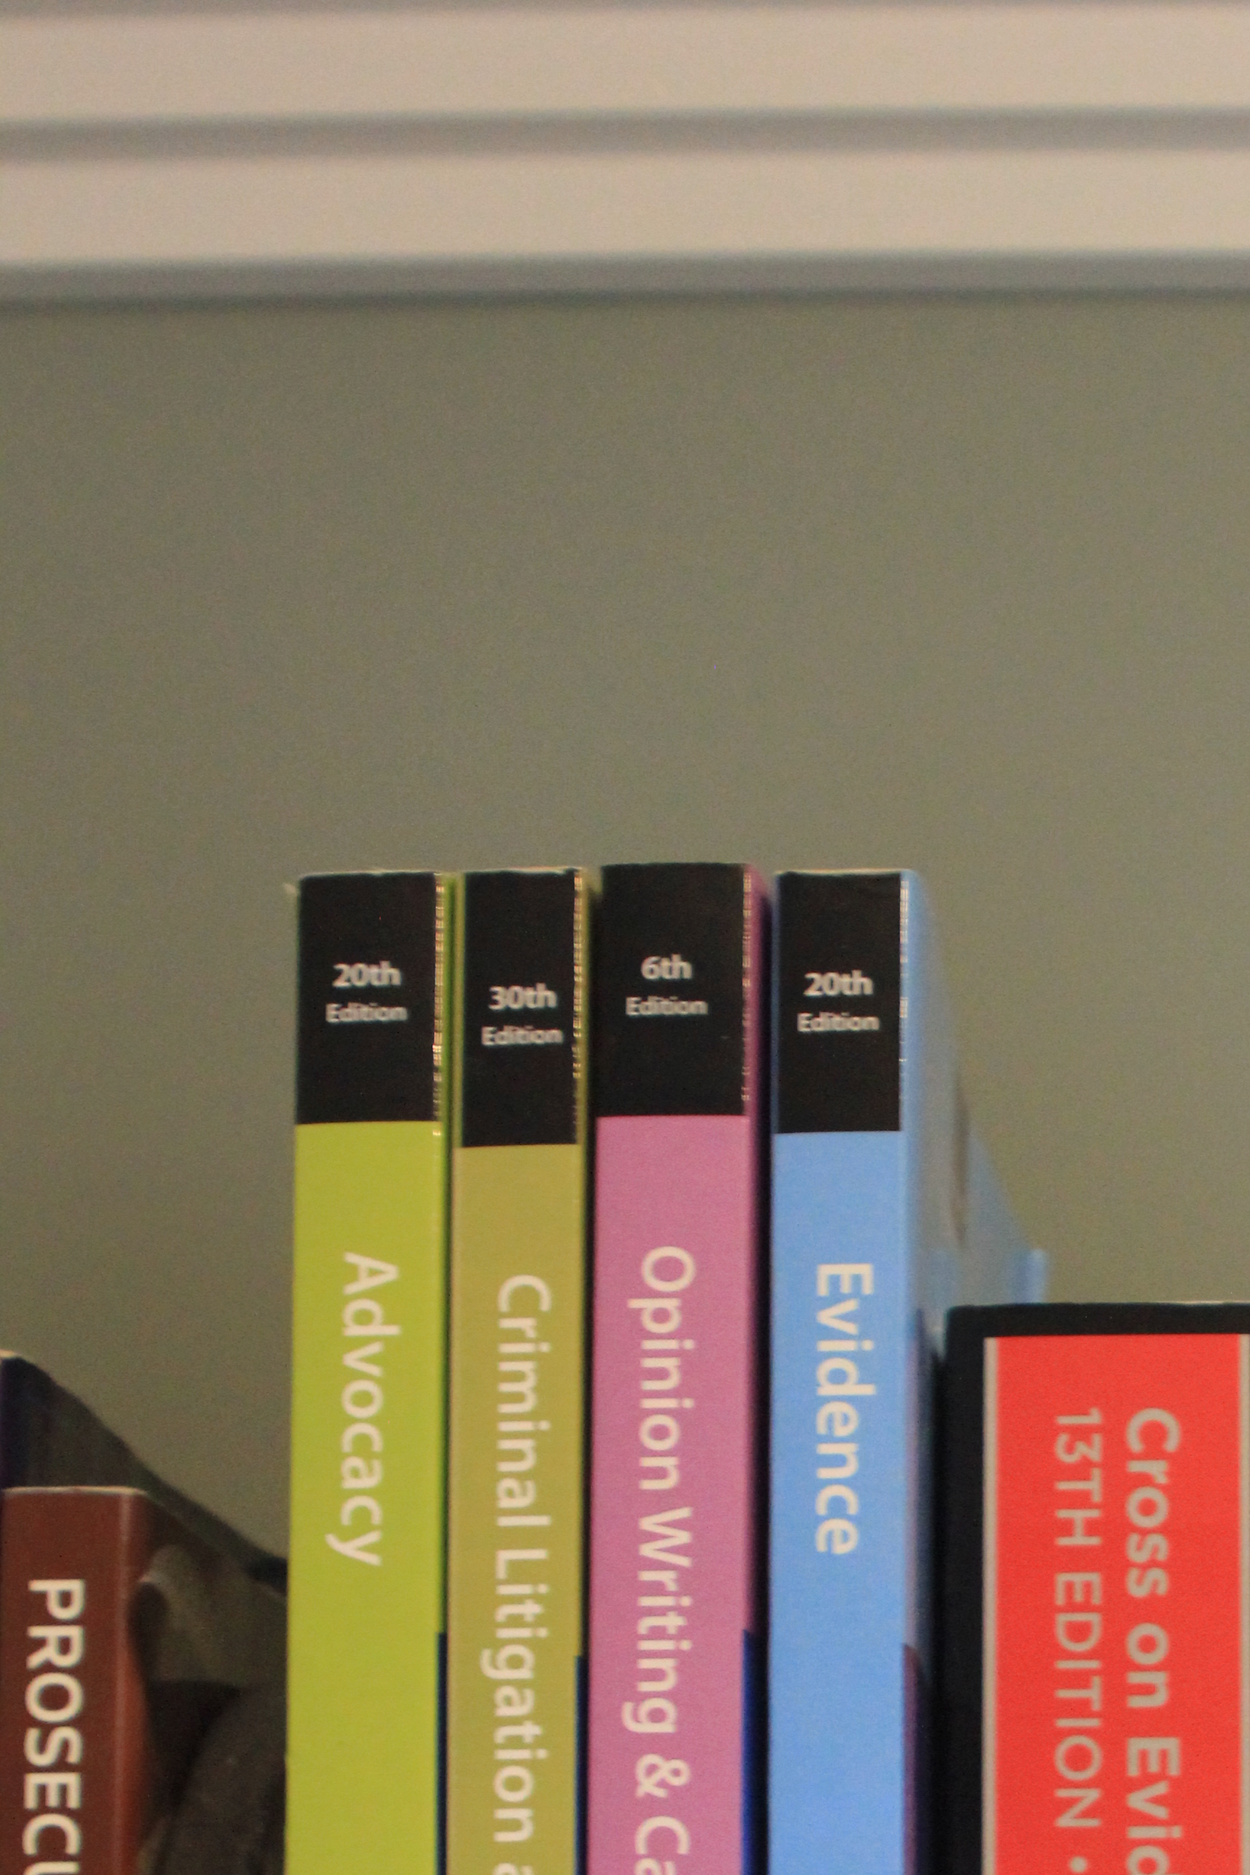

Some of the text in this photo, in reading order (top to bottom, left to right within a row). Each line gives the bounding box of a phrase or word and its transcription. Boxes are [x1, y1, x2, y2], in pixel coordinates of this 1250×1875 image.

[333, 961, 401, 988] 20th
[489, 984, 557, 1011] 30th
[626, 996, 707, 1018] Edition
[640, 954, 692, 981] 6th
[804, 971, 873, 998] 20th
[326, 1003, 407, 1024] Edition
[481, 1025, 563, 1047] Edition
[797, 1012, 879, 1033] Edition
[325, 1252, 400, 1566] Advocacy
[494, 1274, 551, 1527] Criminal
[628, 1245, 696, 1491] Opinion
[816, 1262, 877, 1555] Evidence
[1054, 1408, 1102, 1546] 13TH
[1125, 1406, 1180, 1599] Cross
[622, 1507, 693, 1733] Writing
[480, 1549, 549, 1843] Litigation
[1054, 1572, 1103, 1829] EDITION
[1125, 1621, 1171, 1709] on
[634, 1753, 690, 1798] &
